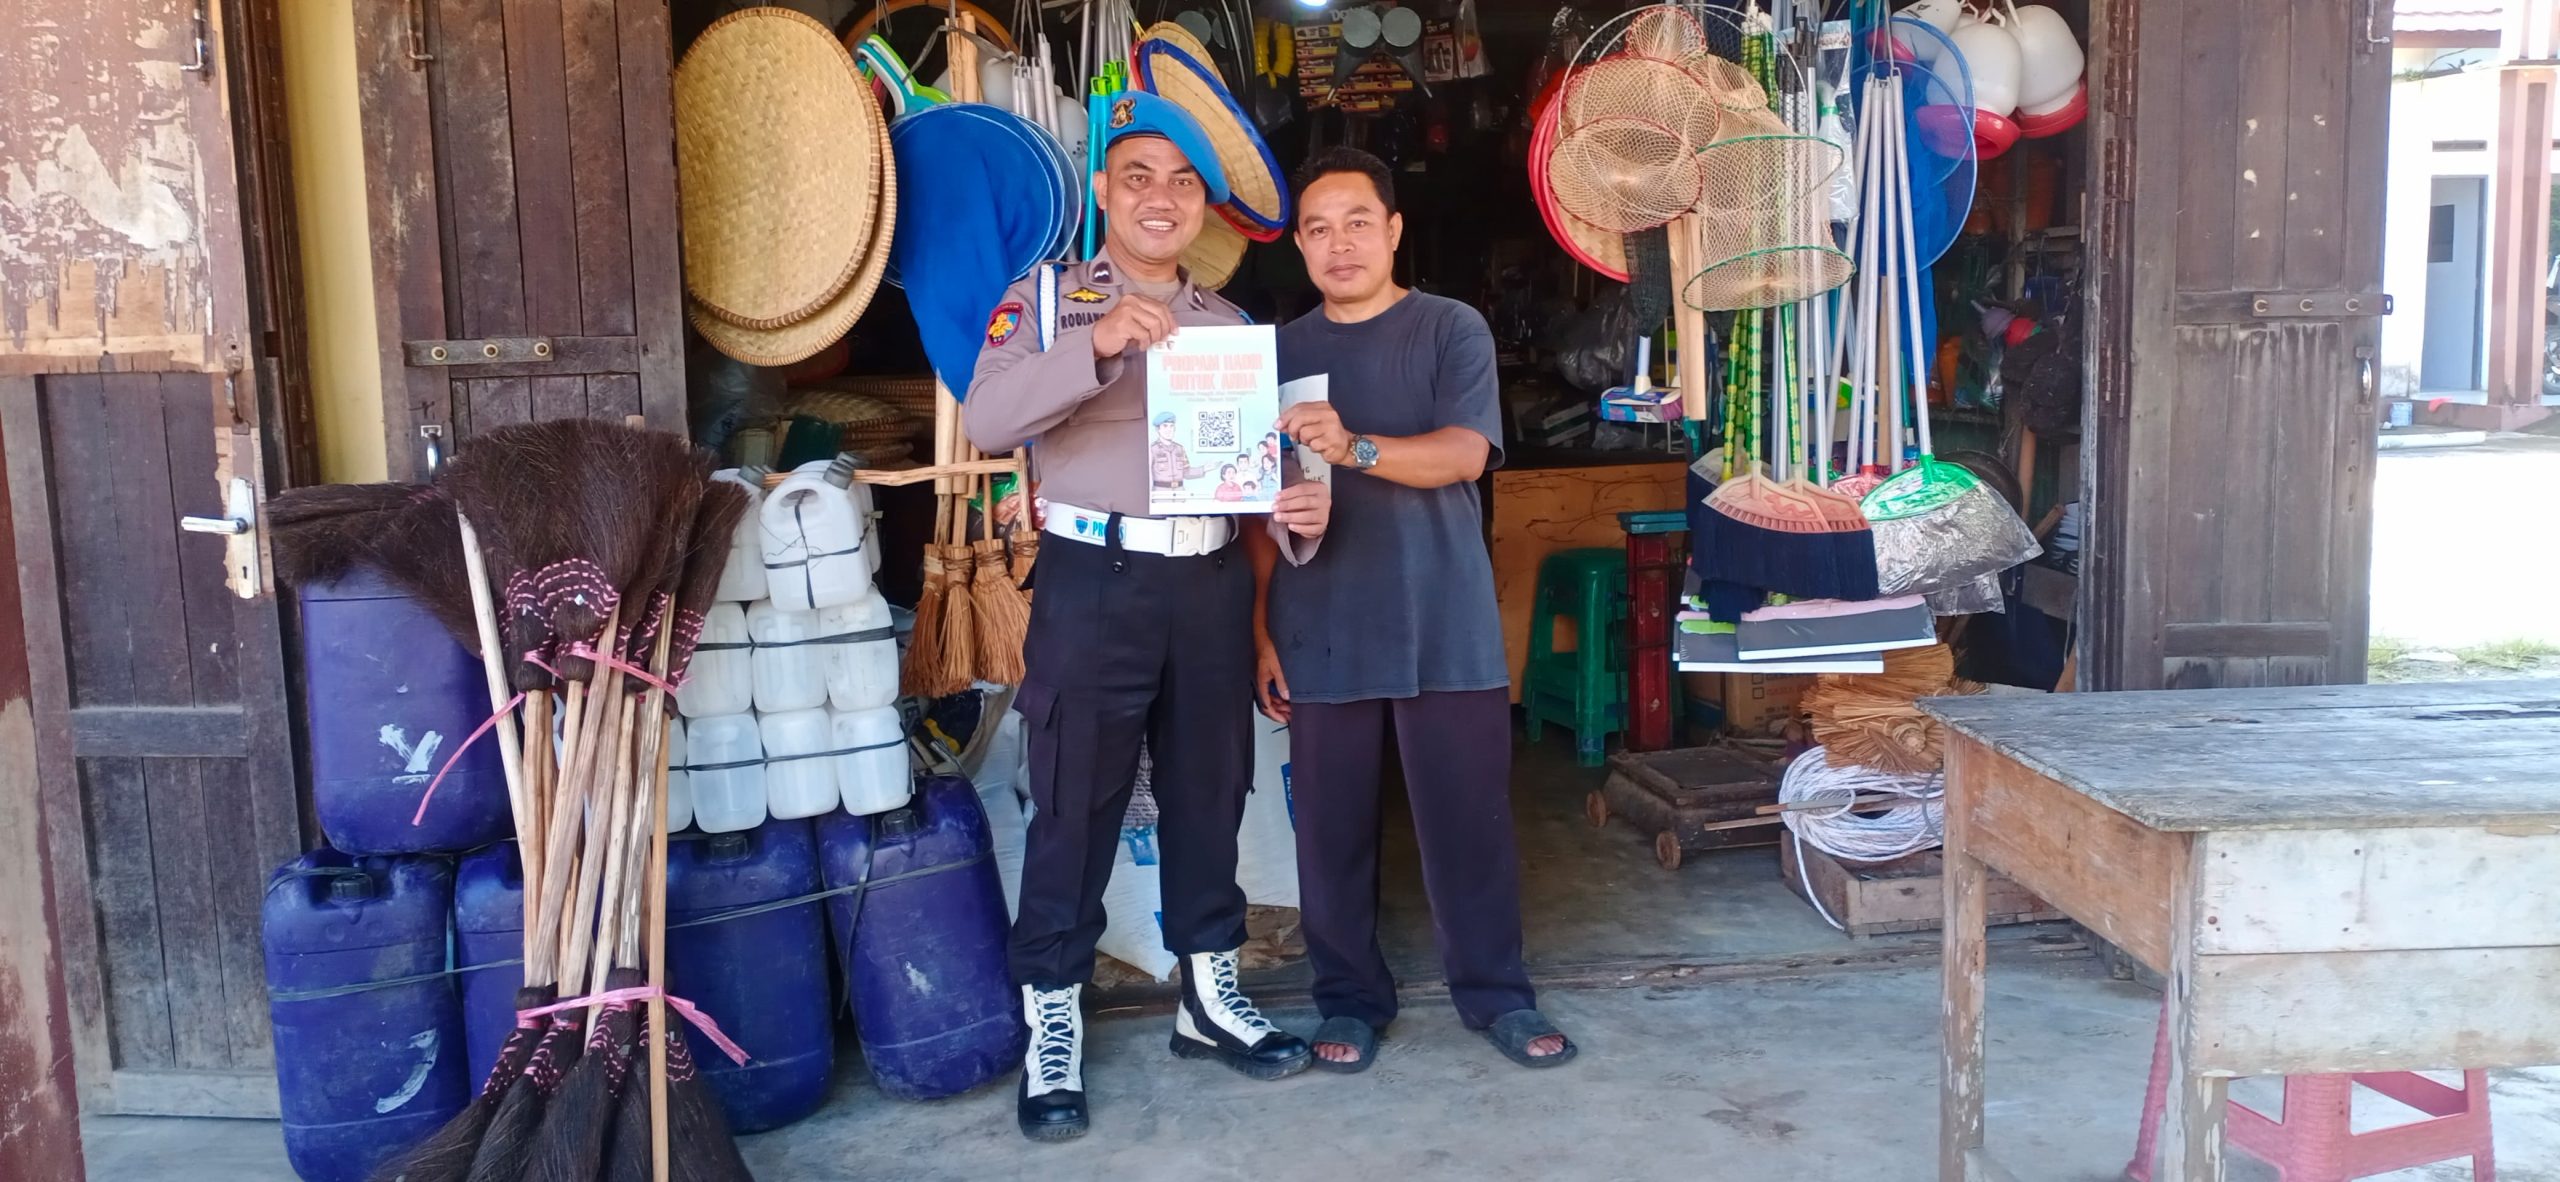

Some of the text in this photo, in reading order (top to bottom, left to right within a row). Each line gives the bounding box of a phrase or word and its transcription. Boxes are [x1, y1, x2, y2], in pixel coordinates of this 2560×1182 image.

[1162, 354, 1219, 371] PROPAM
[1170, 373, 1257, 390] UNTUK ANDA
